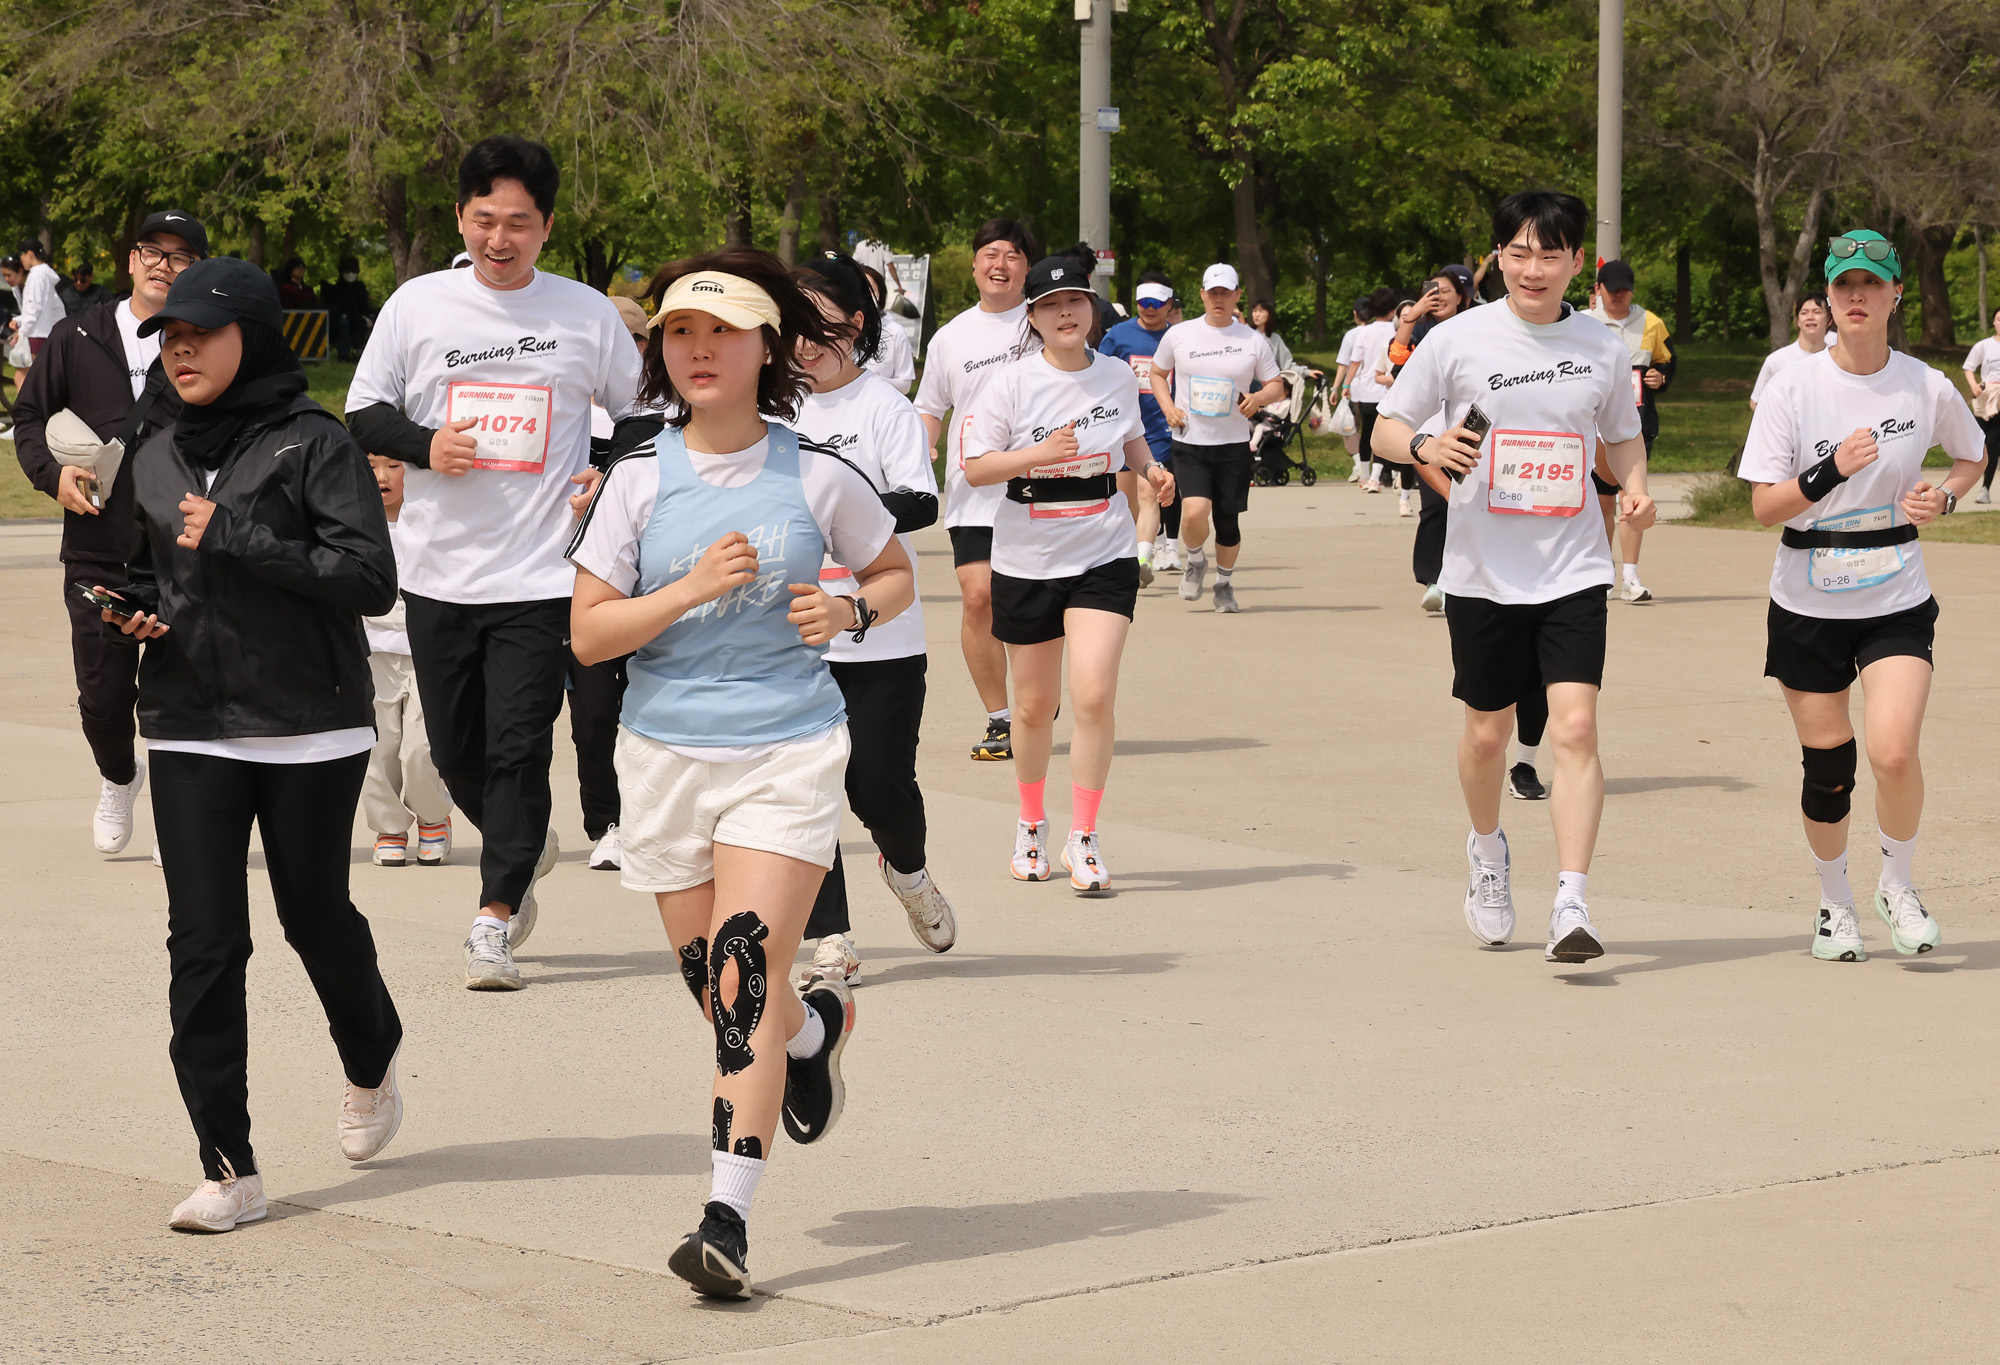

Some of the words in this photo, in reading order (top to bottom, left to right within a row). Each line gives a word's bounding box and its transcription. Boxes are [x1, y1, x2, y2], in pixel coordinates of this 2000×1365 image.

[691, 285, 724, 294] emis
[445, 346, 516, 368] Burning
[518, 336, 558, 354] Run
[1189, 350, 1222, 359] Burning
[1224, 346, 1242, 354] Run
[964, 352, 1008, 373] Burning
[1488, 369, 1556, 391] Burning
[1557, 361, 1592, 377] Run
[457, 391, 496, 400] BURNING
[496, 392, 515, 400] RUN
[524, 395, 544, 403] 10km
[1090, 405, 1120, 422] Run
[479, 414, 537, 435] 1074
[1880, 418, 1915, 438] Run
[827, 433, 859, 448] Run
[1501, 439, 1537, 448] BURNING
[1537, 441, 1555, 449] RUN
[1066, 464, 1081, 472] RUN
[1088, 460, 1105, 468] 10km
[1502, 464, 1516, 475] M
[1518, 462, 1574, 481] 2195
[1499, 491, 1522, 501] C-80
[1844, 519, 1861, 527] RUN
[1873, 514, 1887, 522] 7km
[1823, 575, 1850, 587] D-26
